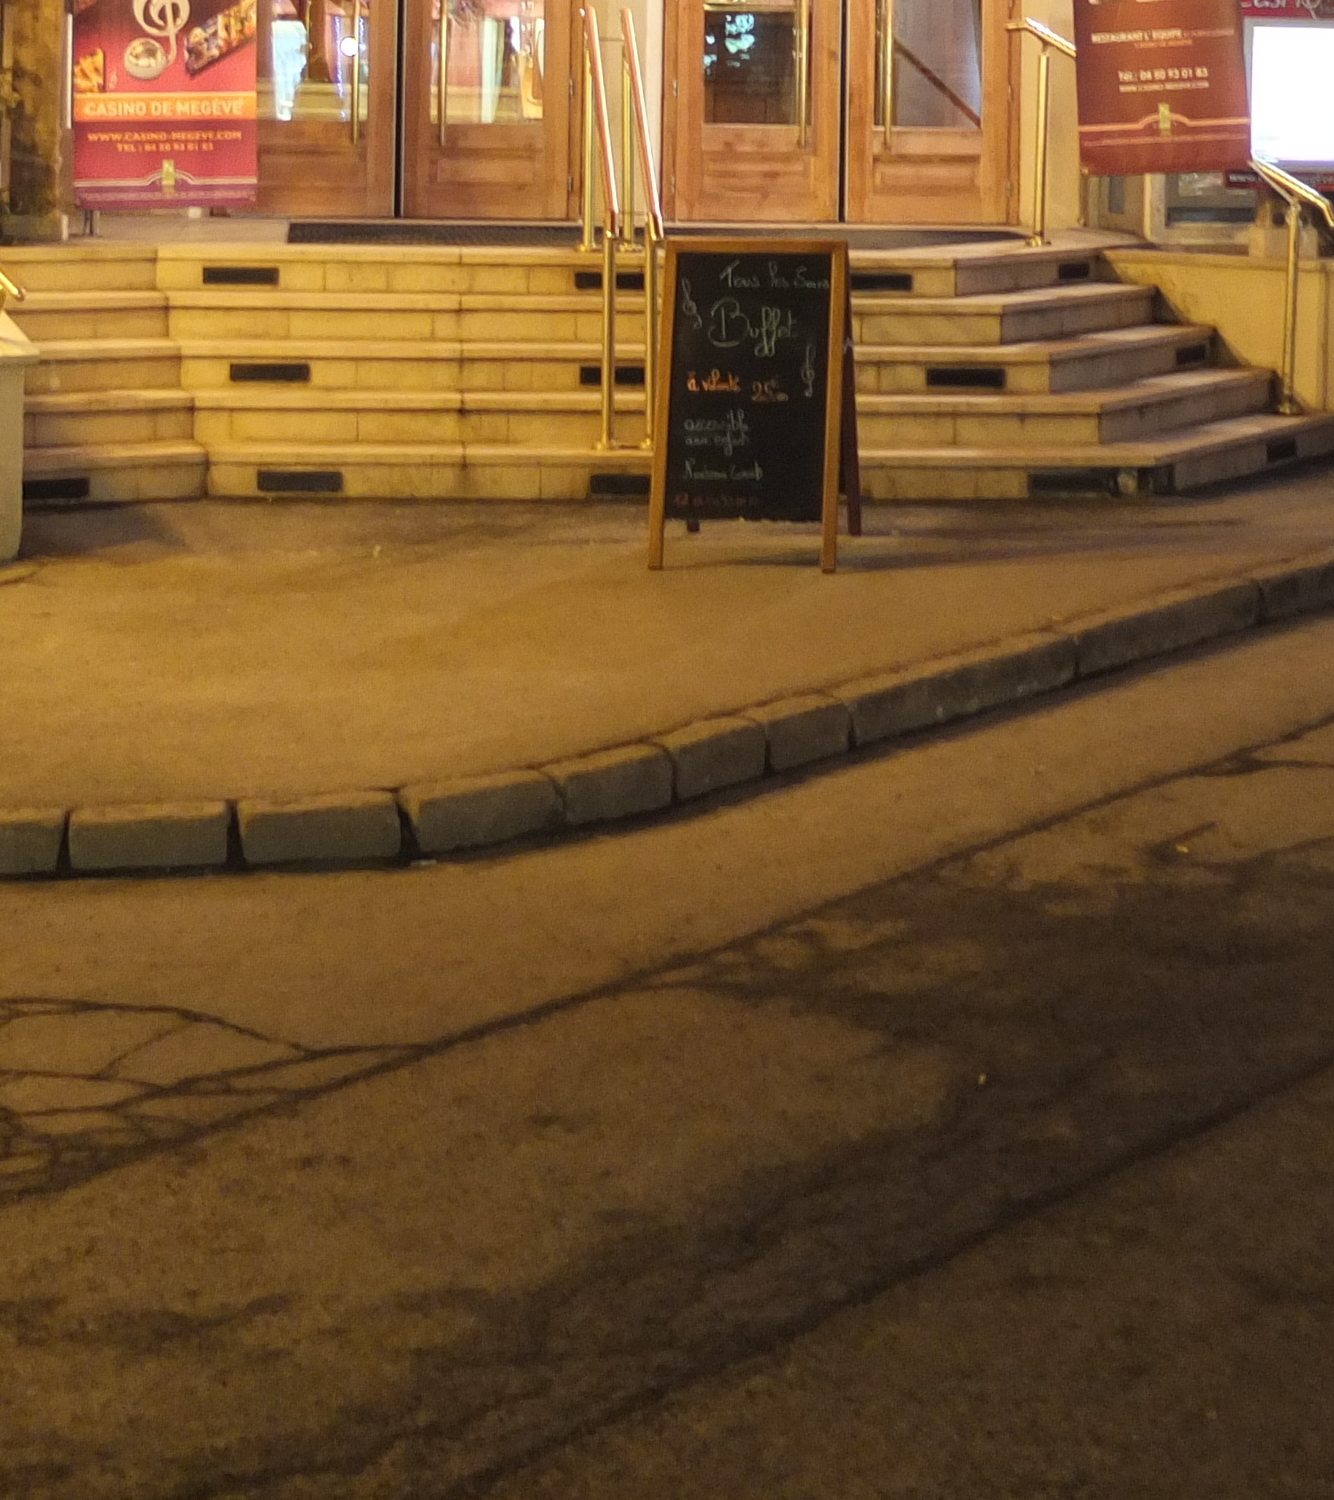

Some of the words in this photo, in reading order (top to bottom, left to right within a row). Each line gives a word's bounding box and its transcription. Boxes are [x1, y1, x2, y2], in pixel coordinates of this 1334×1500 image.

[84, 101, 147, 116] CASINO
[151, 101, 169, 115] DE
[707, 297, 797, 358] Buffet
